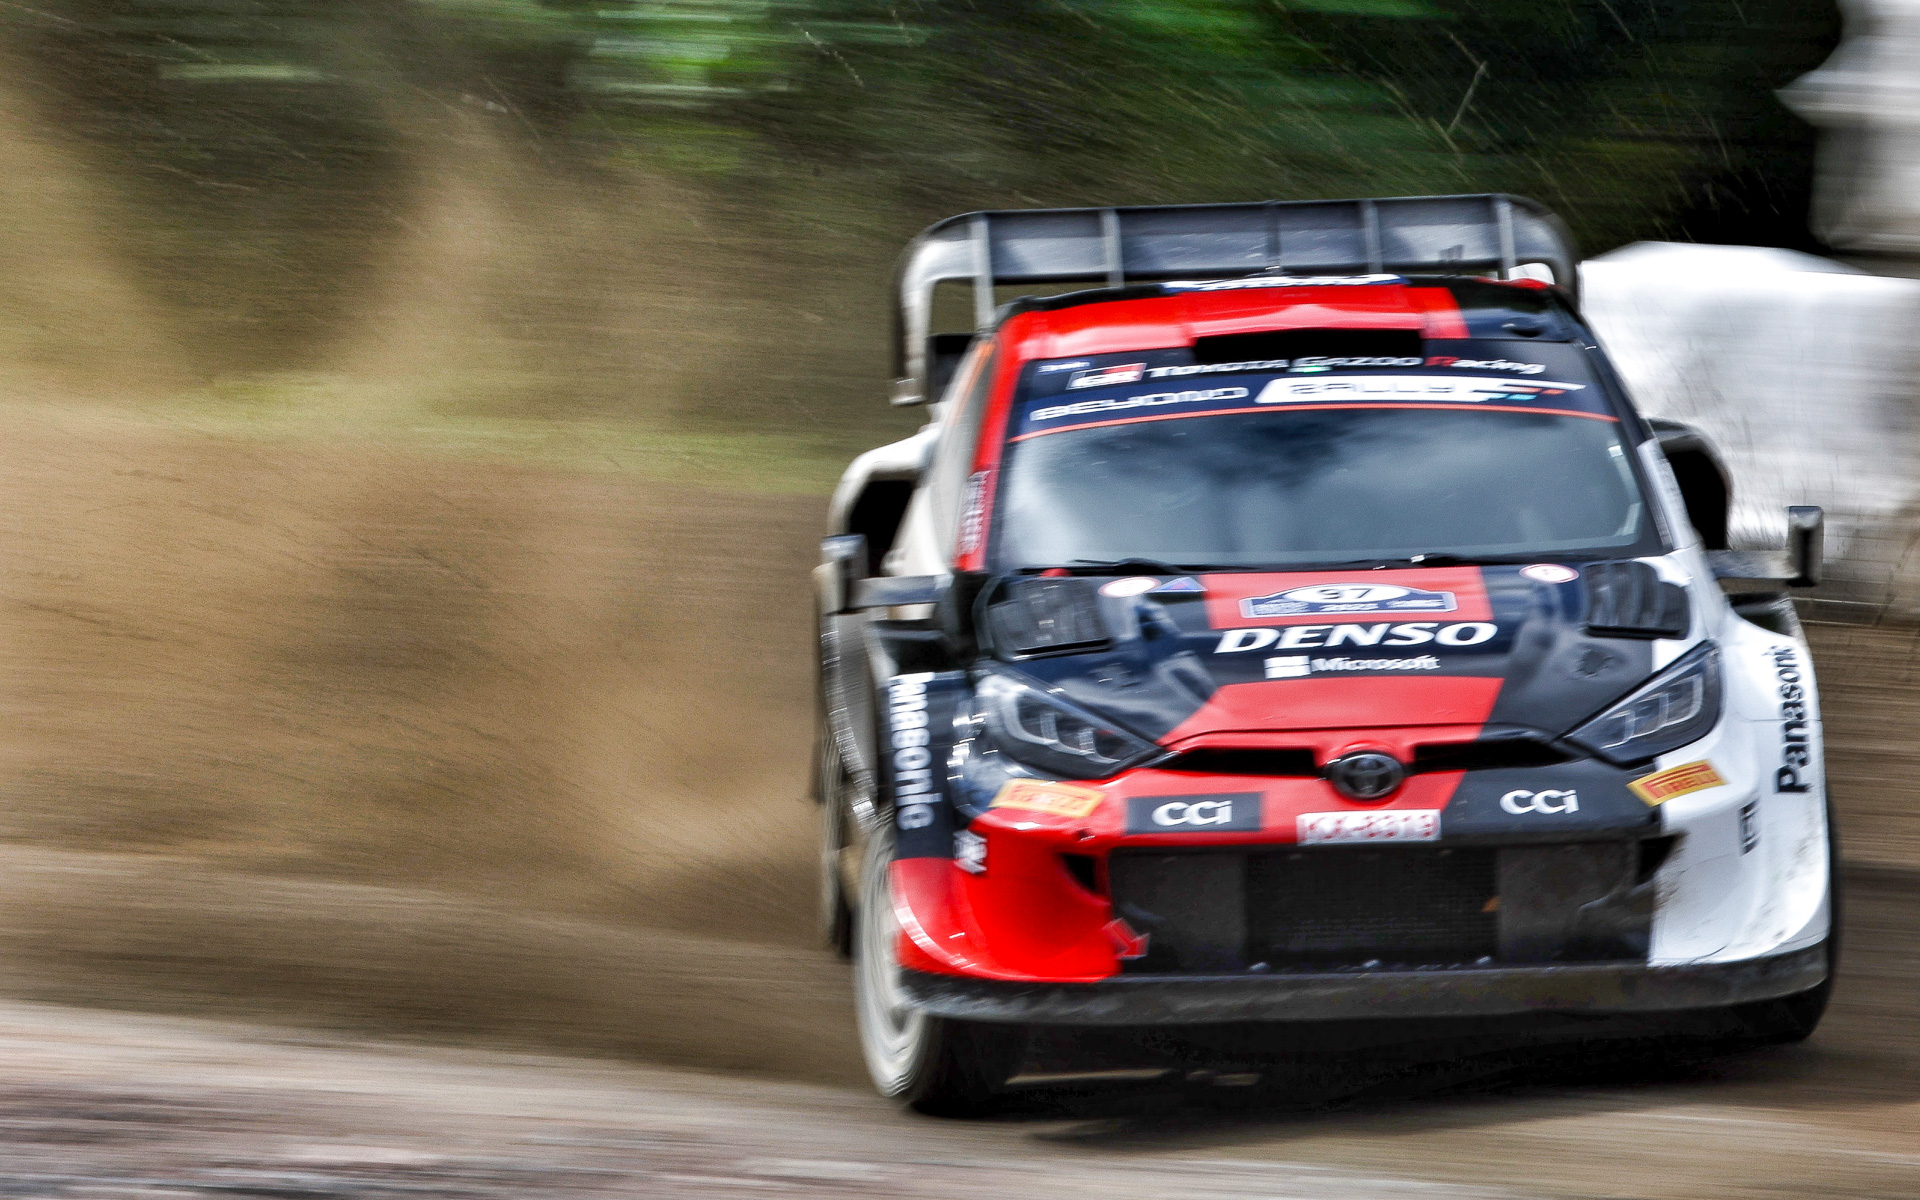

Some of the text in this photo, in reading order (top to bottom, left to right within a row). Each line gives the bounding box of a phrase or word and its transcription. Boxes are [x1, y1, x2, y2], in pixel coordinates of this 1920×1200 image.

[1424, 356, 1546, 375] Racing
[1213, 622, 1499, 654] DENSO
[1311, 655, 1441, 676] Microsoft
